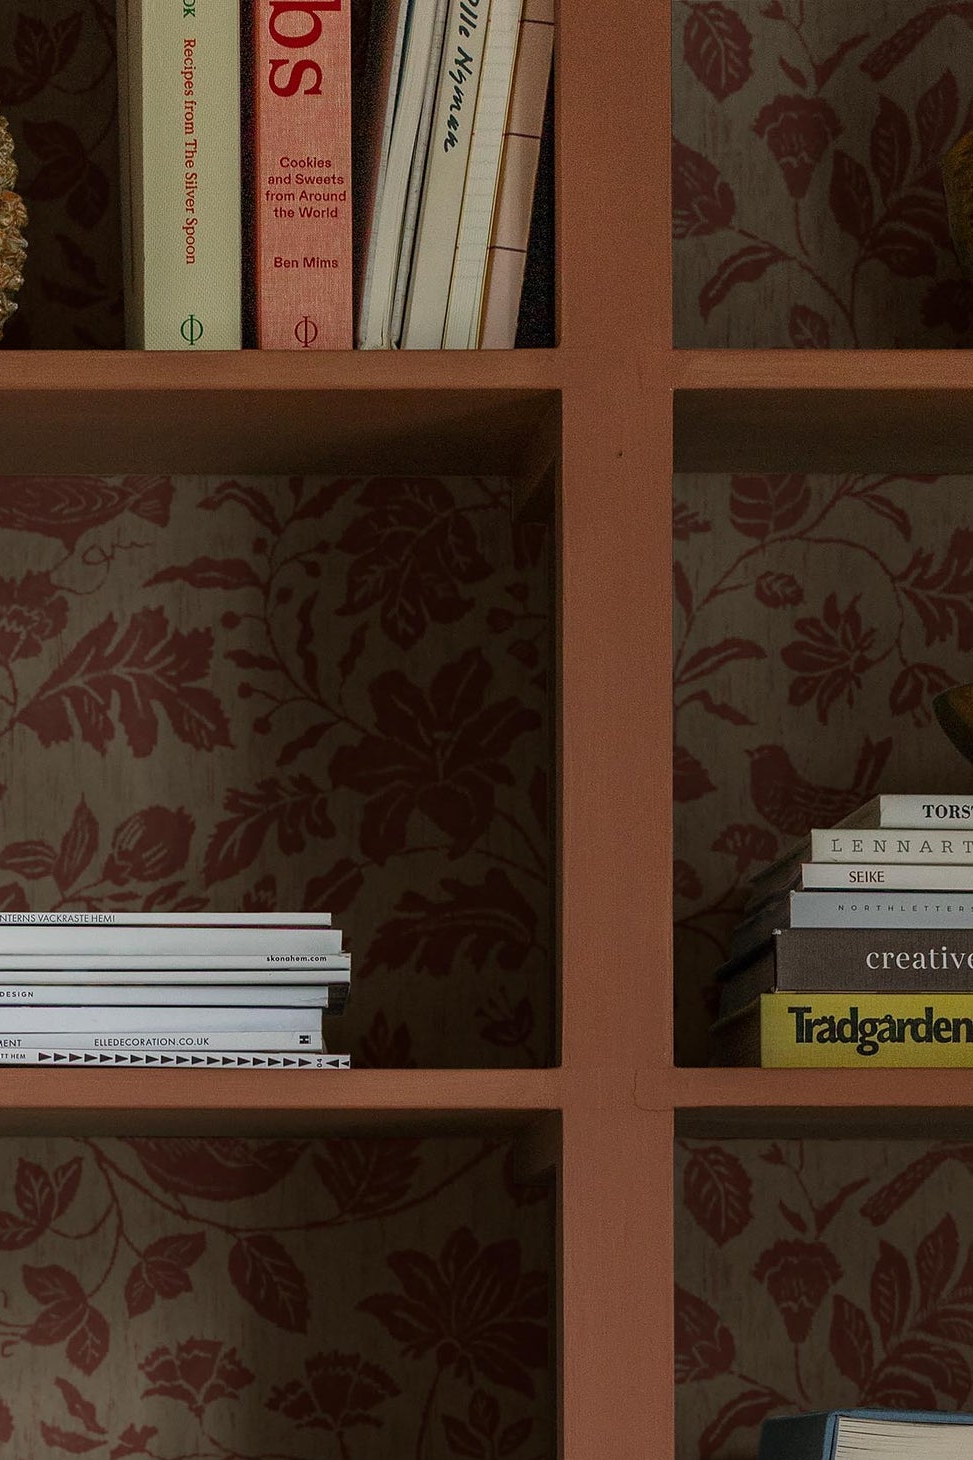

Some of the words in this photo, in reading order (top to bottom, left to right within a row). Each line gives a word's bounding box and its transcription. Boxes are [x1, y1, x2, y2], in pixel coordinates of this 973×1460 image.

[181, 38, 196, 96] Recipes
[184, 100, 197, 135] from
[184, 139, 197, 168] The
[280, 157, 332, 168] Cookies
[268, 174, 291, 185] and
[295, 174, 344, 185] Sweets
[185, 172, 197, 213] Silver
[266, 190, 295, 201] from
[299, 190, 347, 201] Around
[273, 207, 295, 218] the
[299, 207, 338, 218] World
[182, 218, 198, 264] Spoon
[274, 257, 299, 268] Ben
[303, 257, 339, 268] Mims
[922, 804, 973, 818] TORS
[849, 871, 885, 883] SEIKE
[37, 914, 89, 922] VACKRASTE
[94, 1037, 210, 1047] ELLEDECORATION.CO.UK
